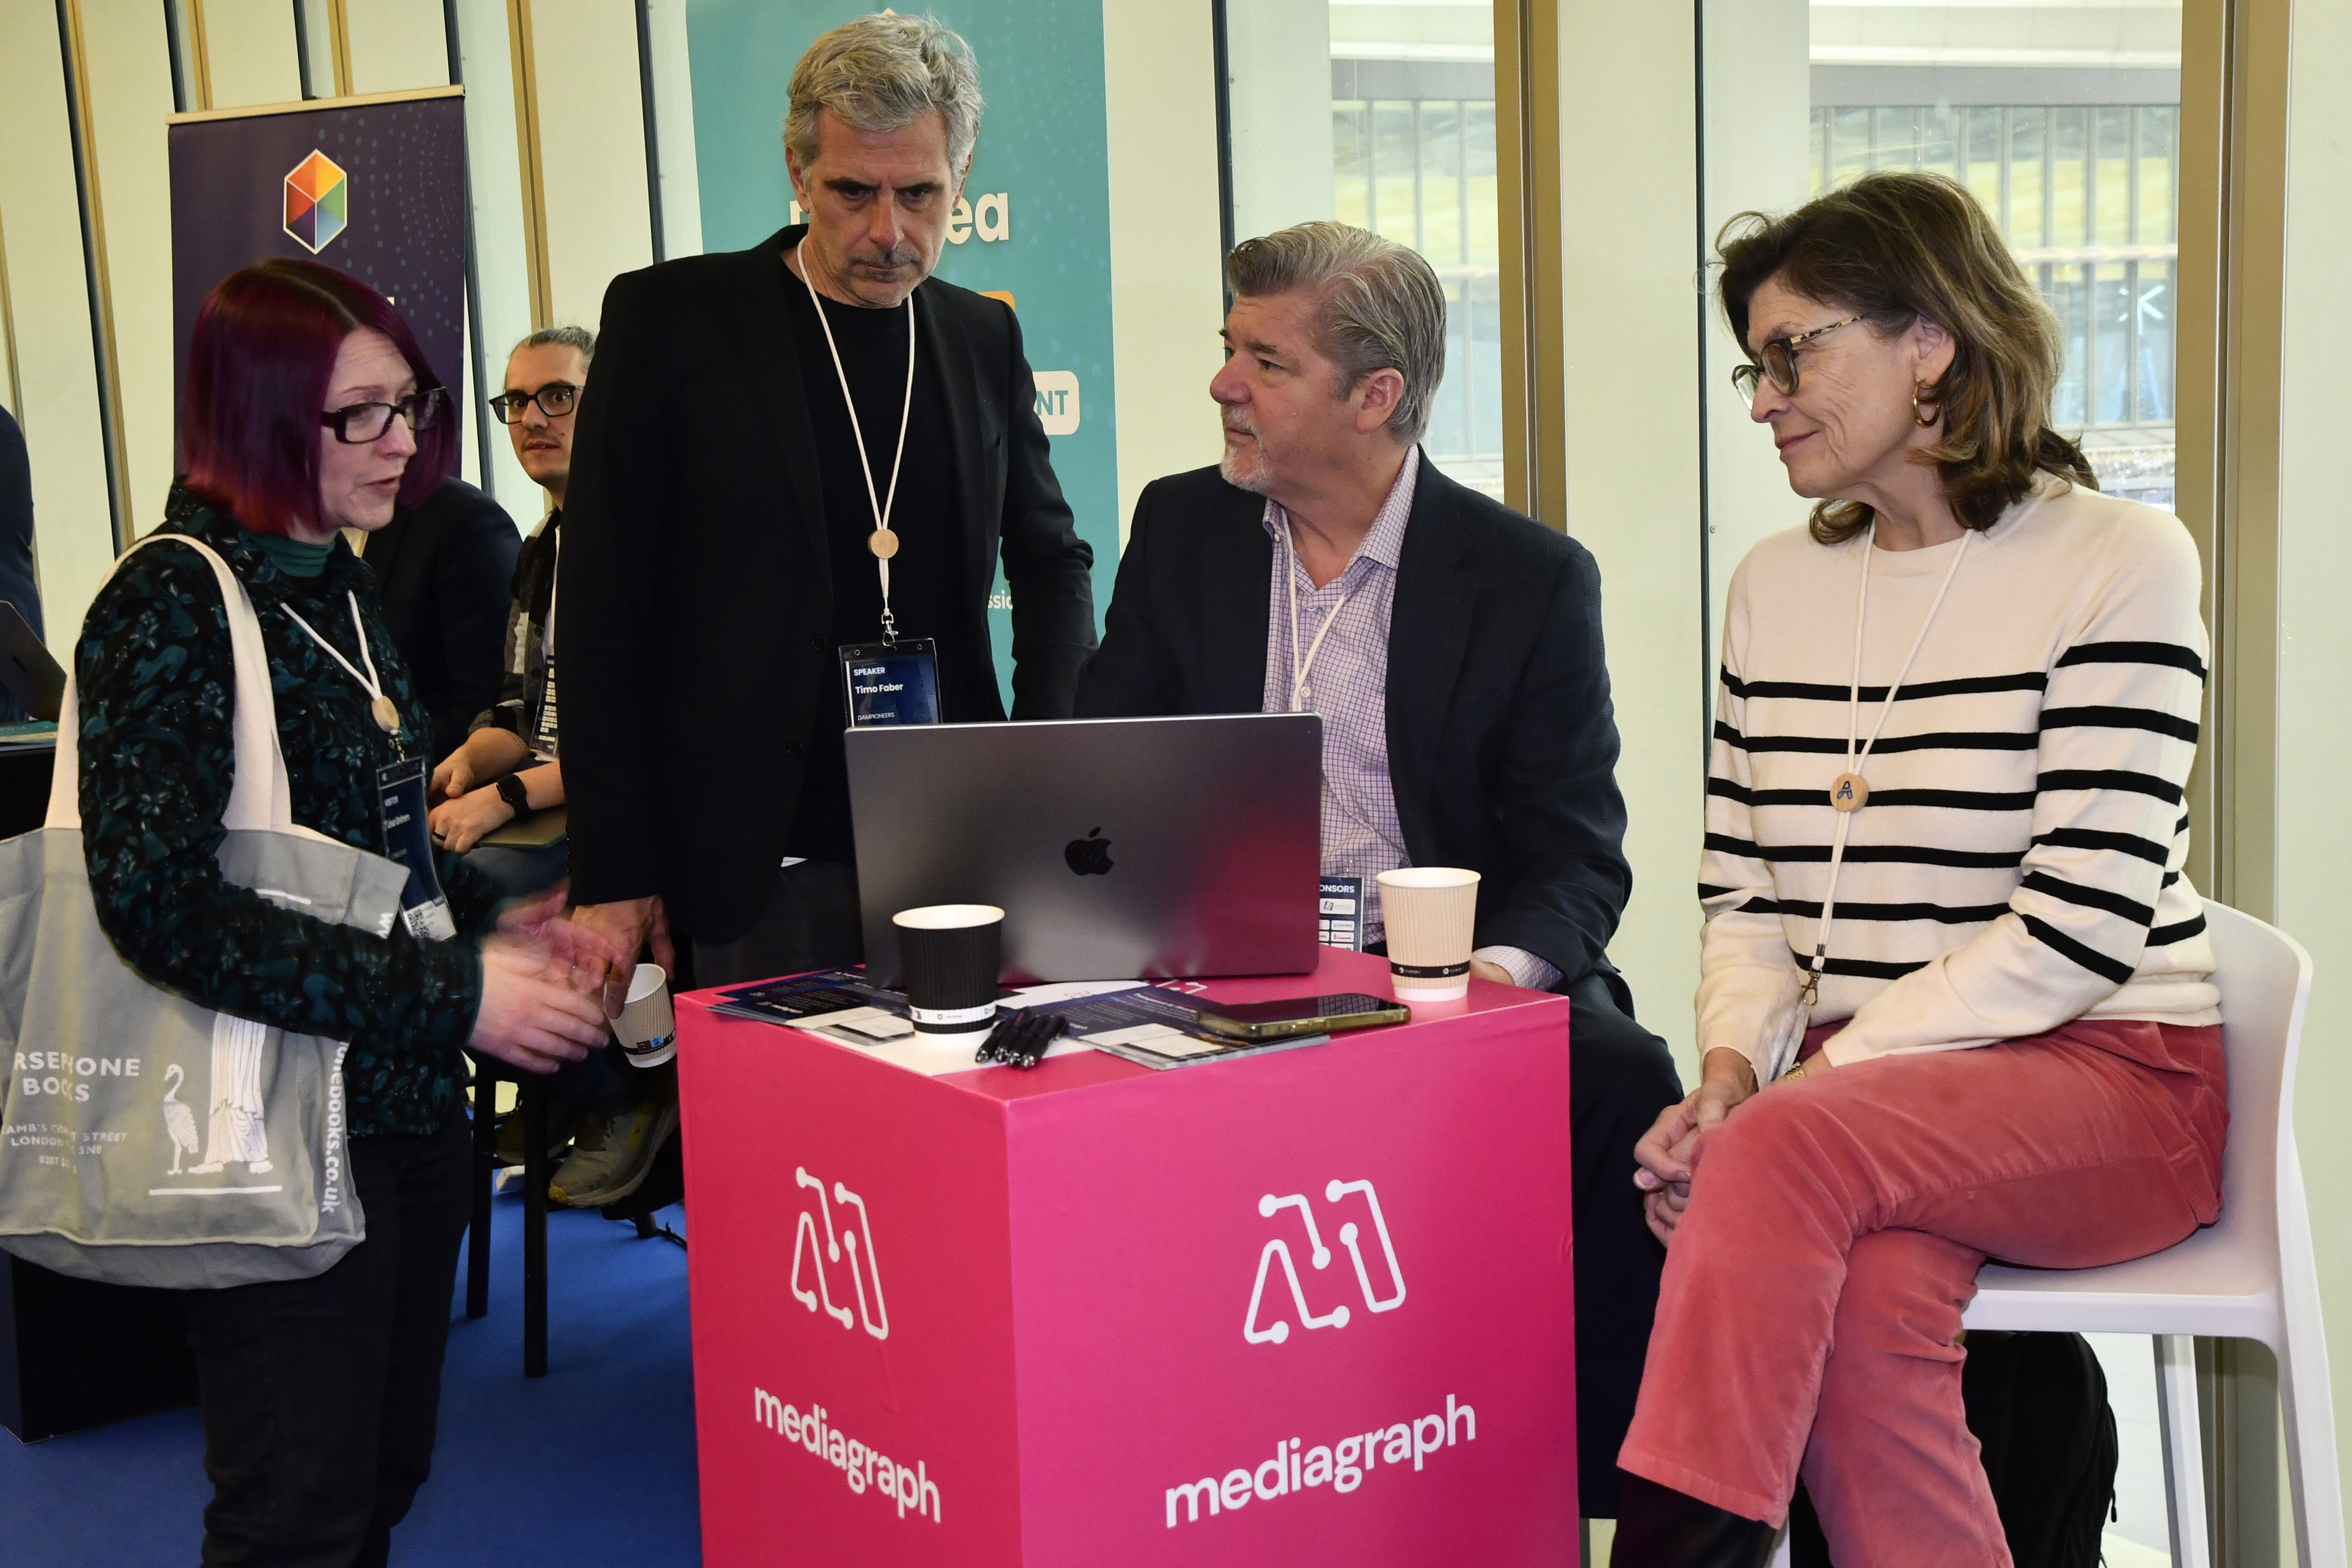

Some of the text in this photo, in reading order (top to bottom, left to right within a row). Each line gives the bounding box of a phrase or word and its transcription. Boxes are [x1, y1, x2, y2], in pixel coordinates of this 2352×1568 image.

[1036, 390, 1069, 415] NT
[853, 667, 885, 676] SPEAKER
[855, 683, 904, 694] Timo Faber
[858, 712, 895, 721] DAMPIONEERS
[1319, 885, 1355, 893] ONSORS
[6, 1123, 48, 1135] AMB'S
[754, 1386, 941, 1524] mediagraph
[1165, 1393, 1476, 1528] mediagraph
